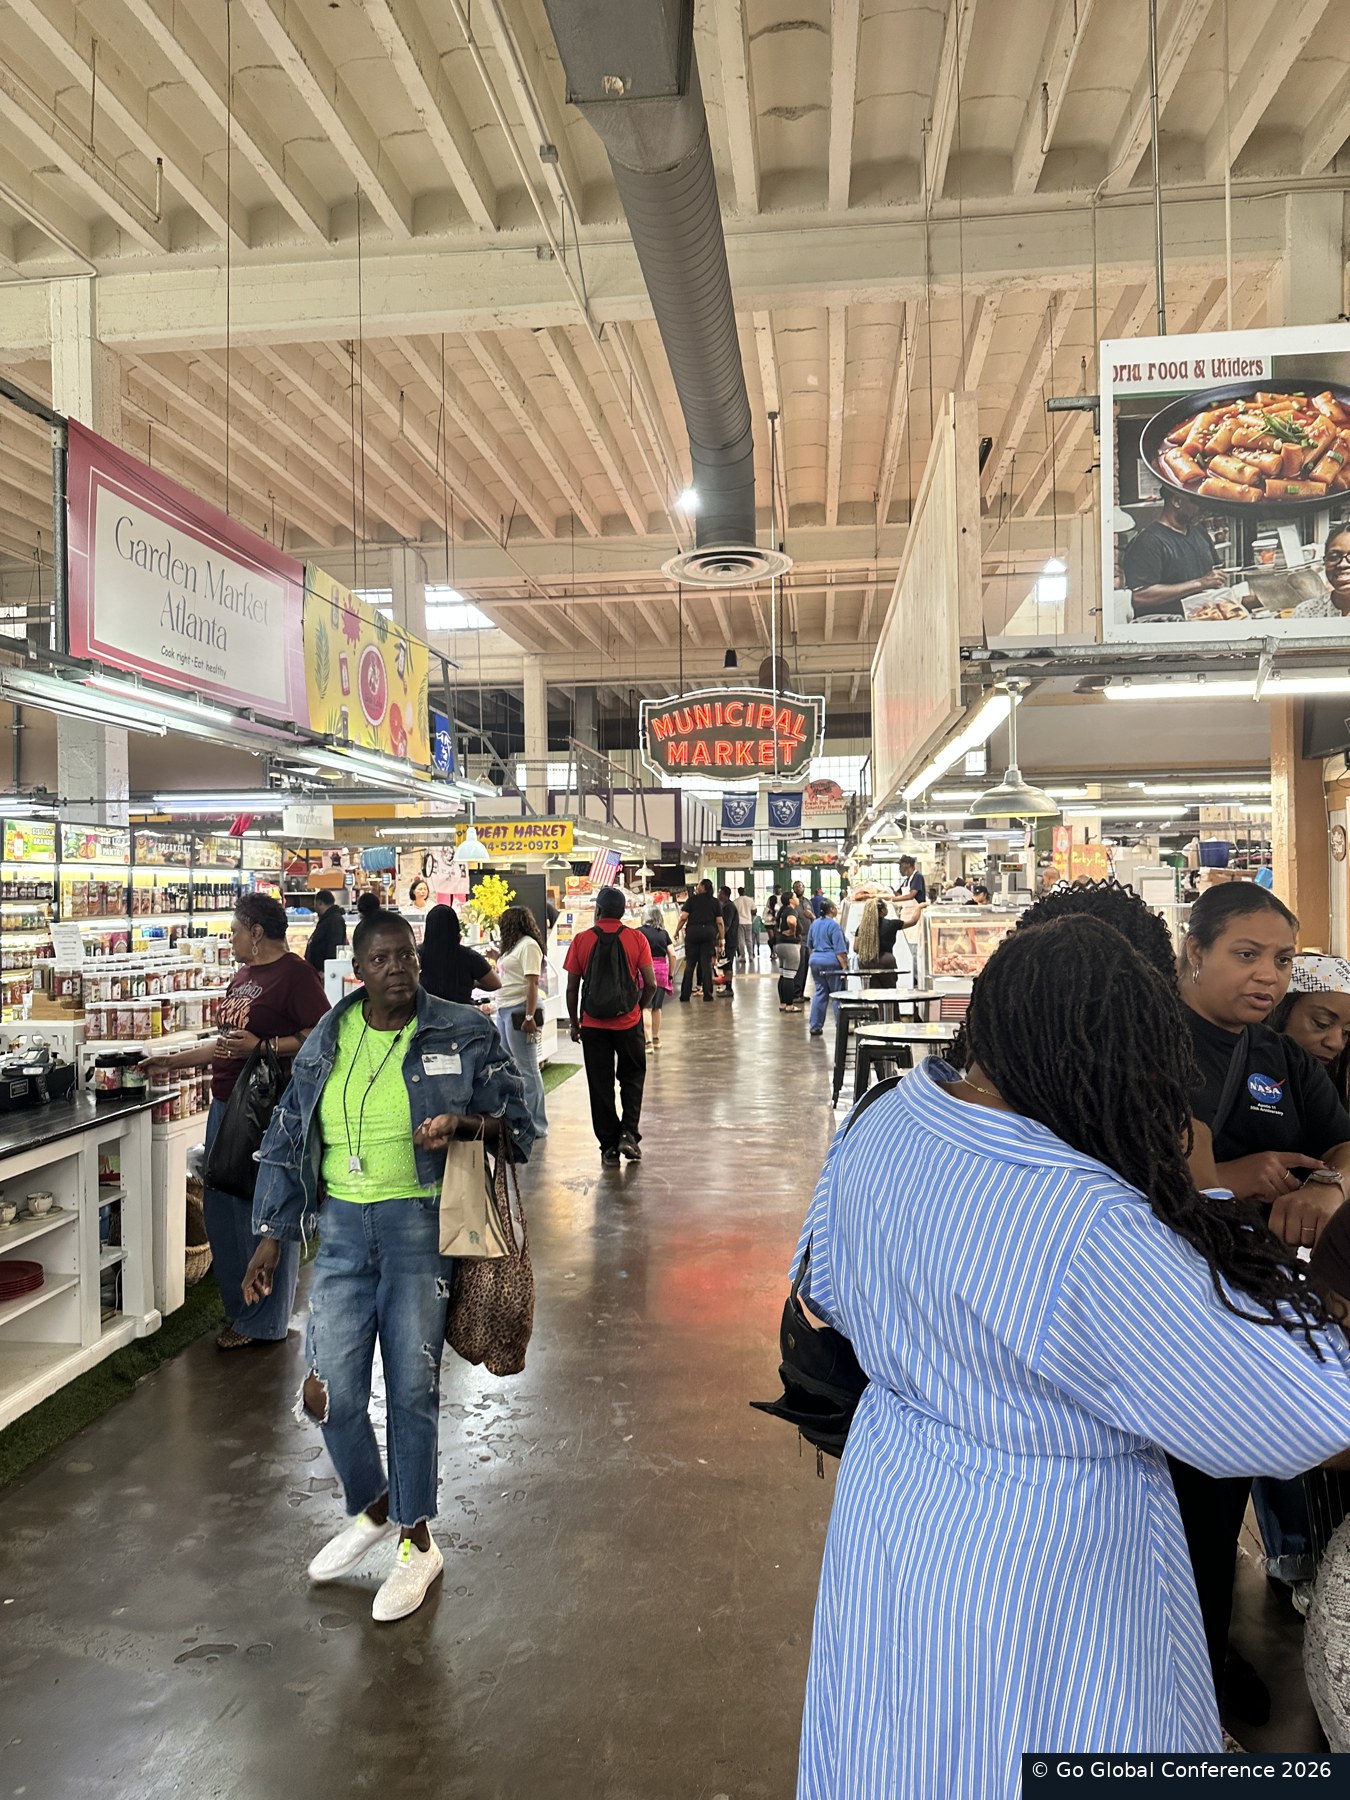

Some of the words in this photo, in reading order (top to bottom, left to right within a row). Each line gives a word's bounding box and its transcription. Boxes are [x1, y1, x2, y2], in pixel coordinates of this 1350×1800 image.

[115, 516, 198, 593] Garden
[204, 560, 269, 627] Market
[160, 589, 228, 652] Atlanta
[161, 645, 175, 659] Cook
[176, 651, 191, 666] right
[194, 658, 205, 669] Eat
[205, 661, 227, 680] healthy
[651, 701, 808, 743] MUNICIPAL
[667, 740, 798, 766] MARKET
[475, 825, 509, 839] MEAT
[513, 824, 567, 838] MARKET
[157, 842, 191, 853] BREAKFAST
[1250, 1081, 1281, 1096] NASA
